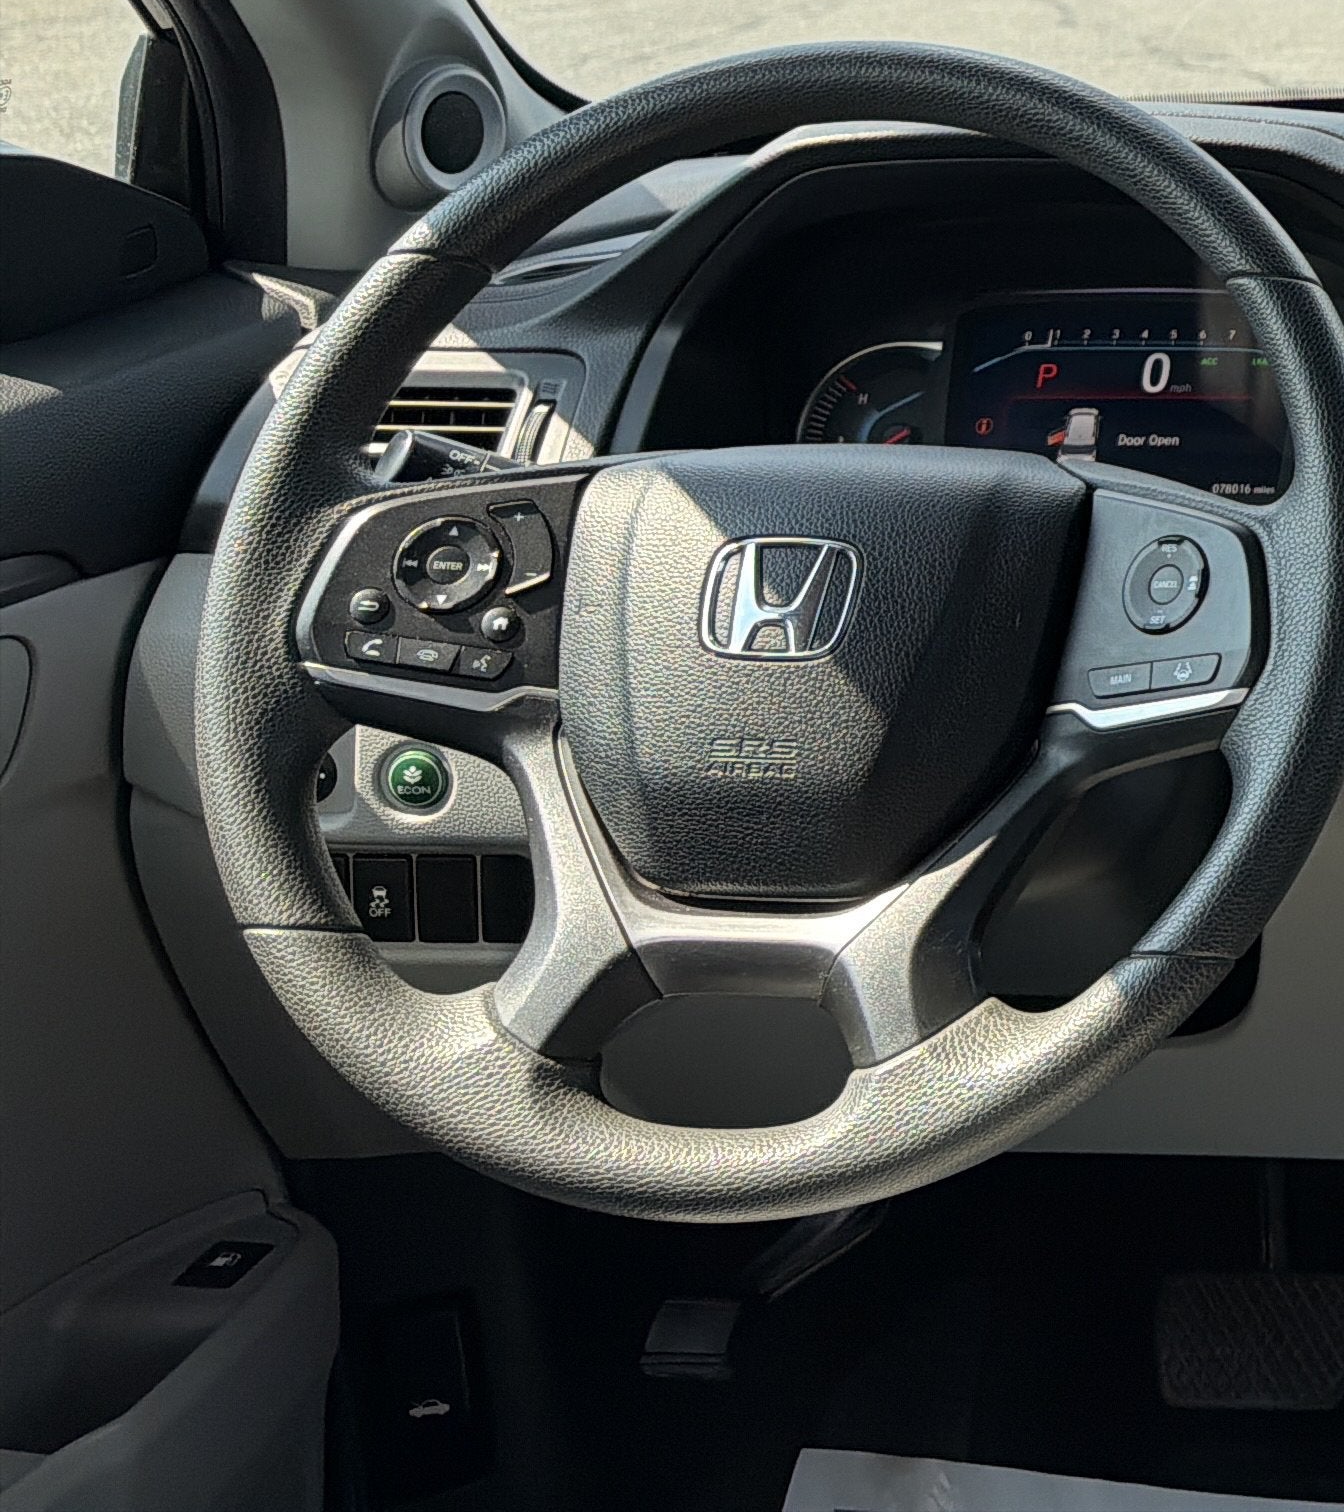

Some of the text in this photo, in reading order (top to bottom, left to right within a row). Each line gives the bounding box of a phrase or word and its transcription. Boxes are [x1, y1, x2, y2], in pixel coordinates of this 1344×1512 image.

[1201, 357, 1218, 365] ACC
[1252, 357, 1270, 366] LKA
[1036, 363, 1058, 389] P
[1141, 352, 1172, 394] 0
[1169, 383, 1193, 394] mph
[858, 393, 869, 404] H
[1117, 434, 1180, 448] Door Open
[449, 449, 475, 464] OFF
[1212, 483, 1275, 495] 078016 miles
[1161, 544, 1177, 552] RES
[433, 561, 463, 570] ENTER
[1153, 580, 1178, 588] CANCEL
[1150, 615, 1166, 624] SET
[1109, 674, 1132, 685] MAIN
[708, 738, 798, 758] SRS
[397, 785, 431, 795] ECON
[368, 908, 392, 918] OFF
